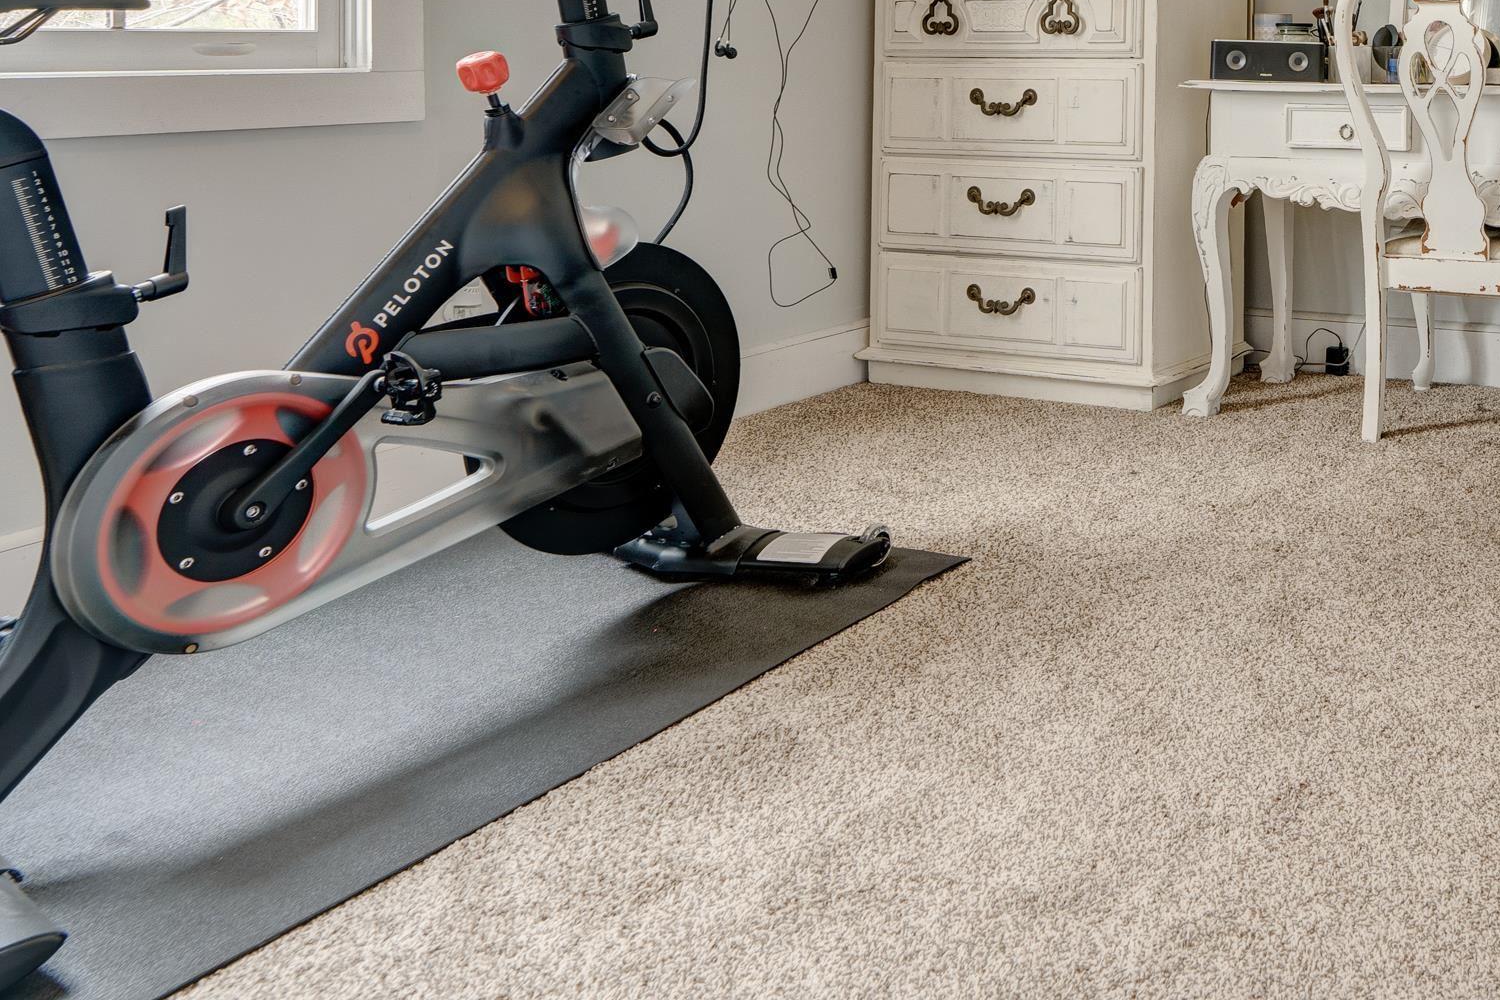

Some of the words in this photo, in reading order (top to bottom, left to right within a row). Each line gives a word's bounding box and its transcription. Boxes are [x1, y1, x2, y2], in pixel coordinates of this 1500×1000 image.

[38, 187, 45, 195] 3
[44, 205, 51, 213] 5
[48, 214, 54, 222] 6
[50, 223, 56, 231] 7
[56, 241, 62, 249] 9
[58, 249, 69, 258] 10
[61, 259, 71, 267] 11
[64, 267, 75, 275] 12
[67, 276, 78, 284] 13
[372, 239, 454, 328] PELOTON
